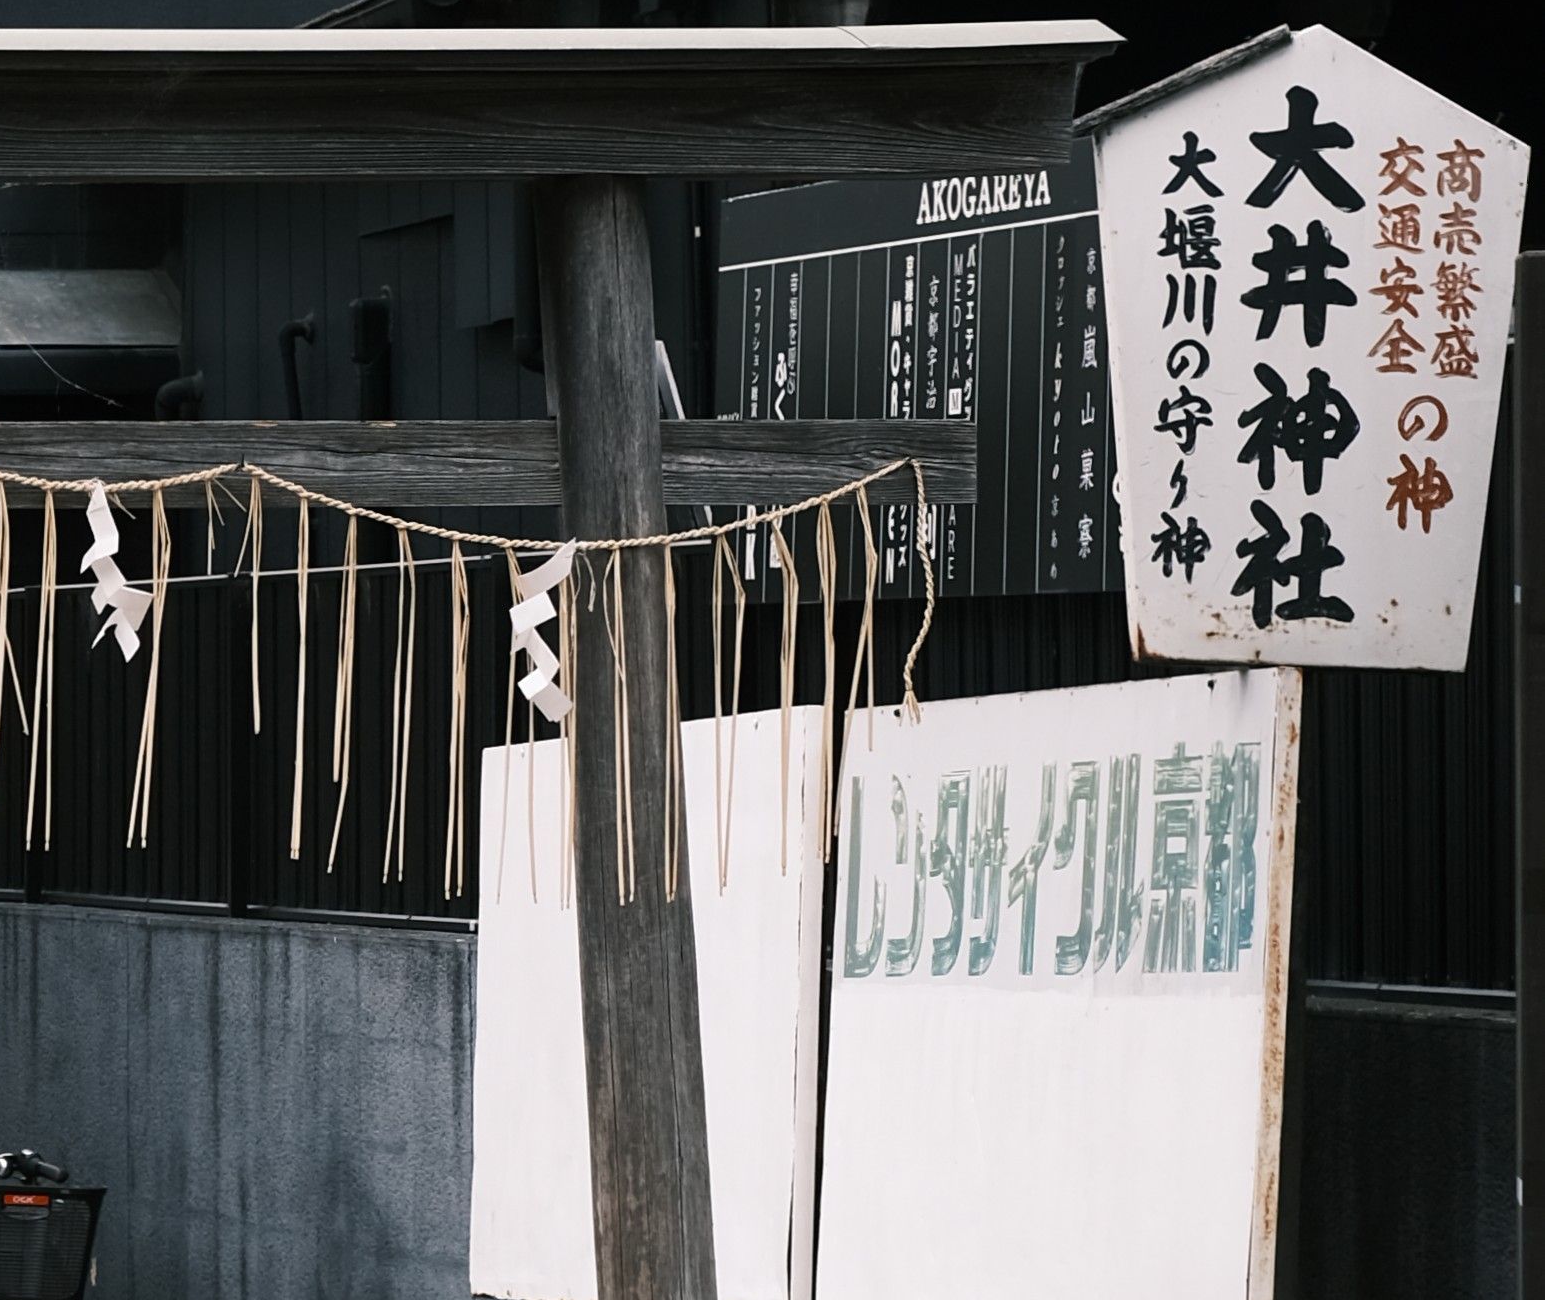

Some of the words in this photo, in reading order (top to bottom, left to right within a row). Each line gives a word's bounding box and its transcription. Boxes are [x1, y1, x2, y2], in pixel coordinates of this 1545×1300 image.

[916, 170, 1051, 226] AKOGAREYA
[951, 253, 964, 380] MEDIA
[1367, 137, 1428, 376] 交通安全
[1431, 138, 1486, 380] 商売繁盛
[1150, 130, 1226, 584] 大堰川の守り神
[1230, 85, 1367, 630] 大井神社
[1385, 394, 1455, 535] の神
